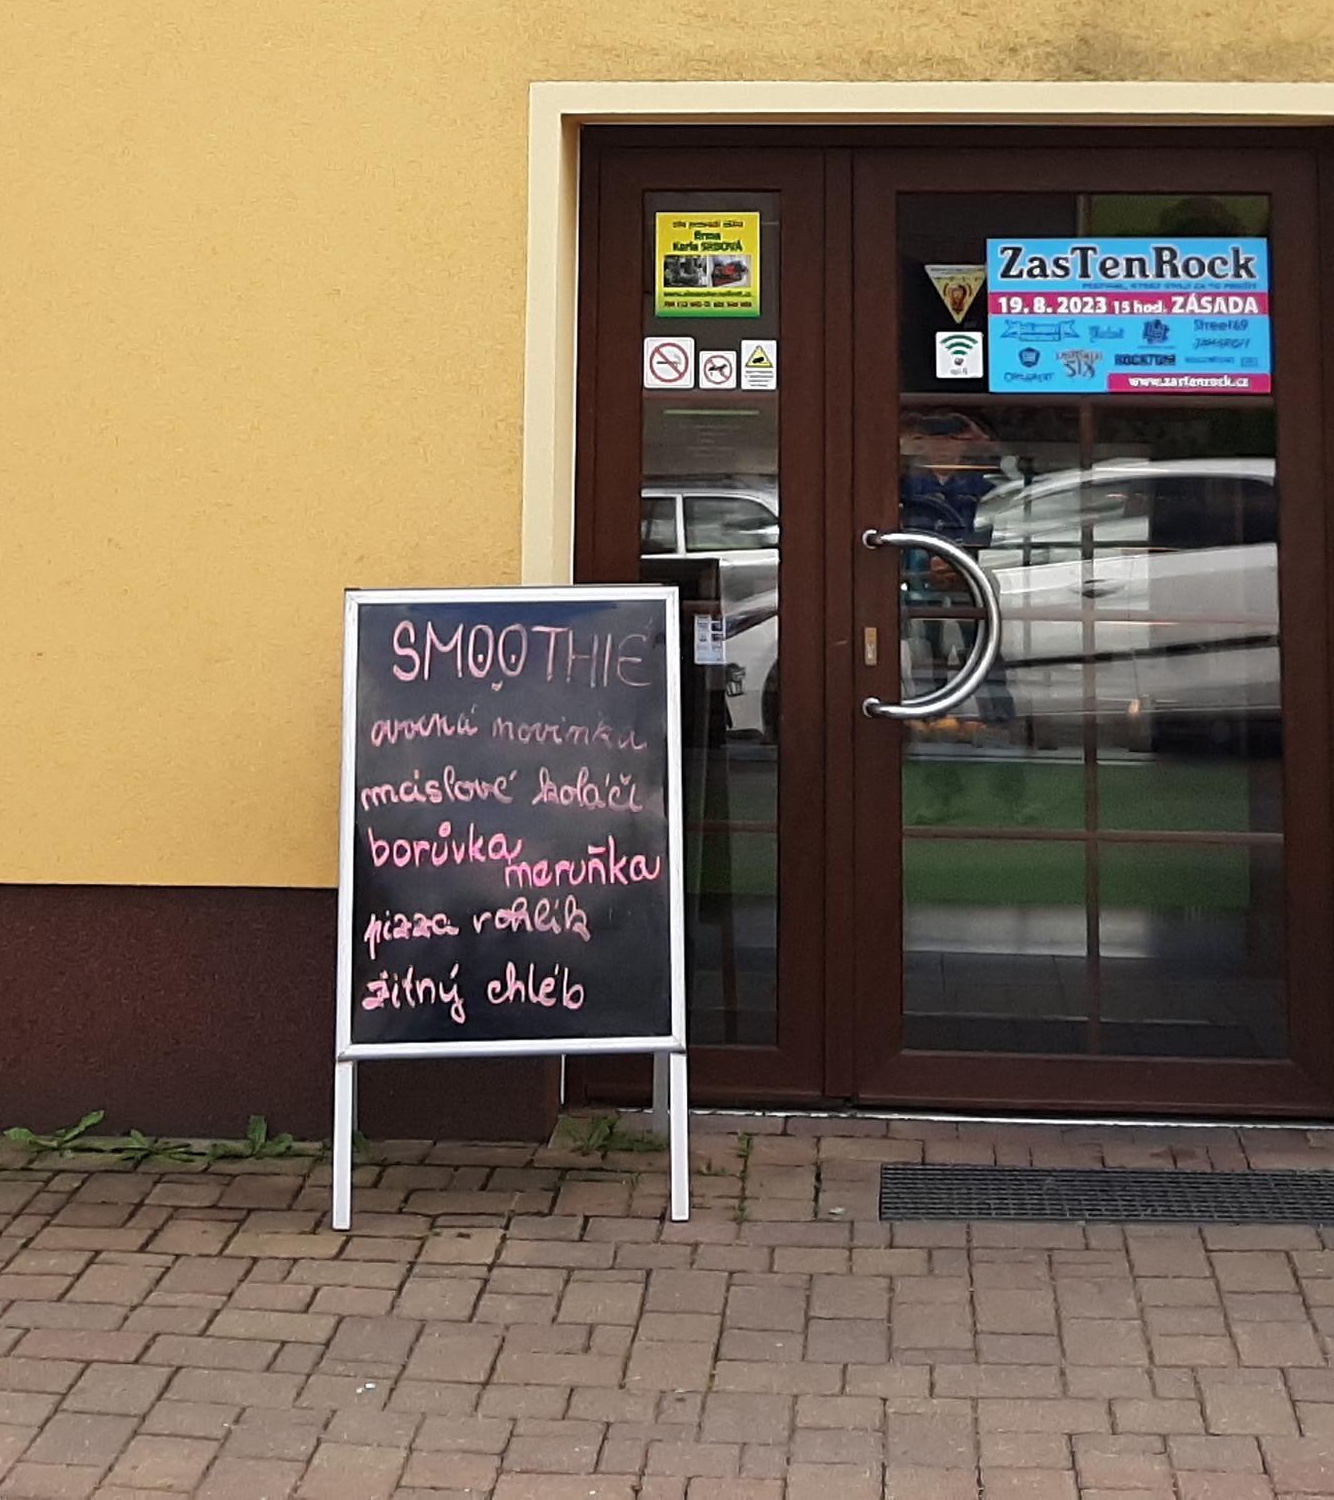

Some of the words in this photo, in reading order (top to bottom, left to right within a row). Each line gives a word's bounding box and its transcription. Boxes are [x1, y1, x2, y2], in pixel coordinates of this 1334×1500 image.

[998, 244, 1257, 281] ZasTenRock
[998, 296, 1029, 314] 19.
[1033, 296, 1052, 314] 8.
[1056, 296, 1107, 314] 2023
[1170, 292, 1259, 314] ZÁSADA
[392, 619, 651, 689] SMOOTHIE
[367, 820, 524, 869] borůvka
[364, 908, 459, 960] pizza
[487, 961, 585, 1010] chléb
